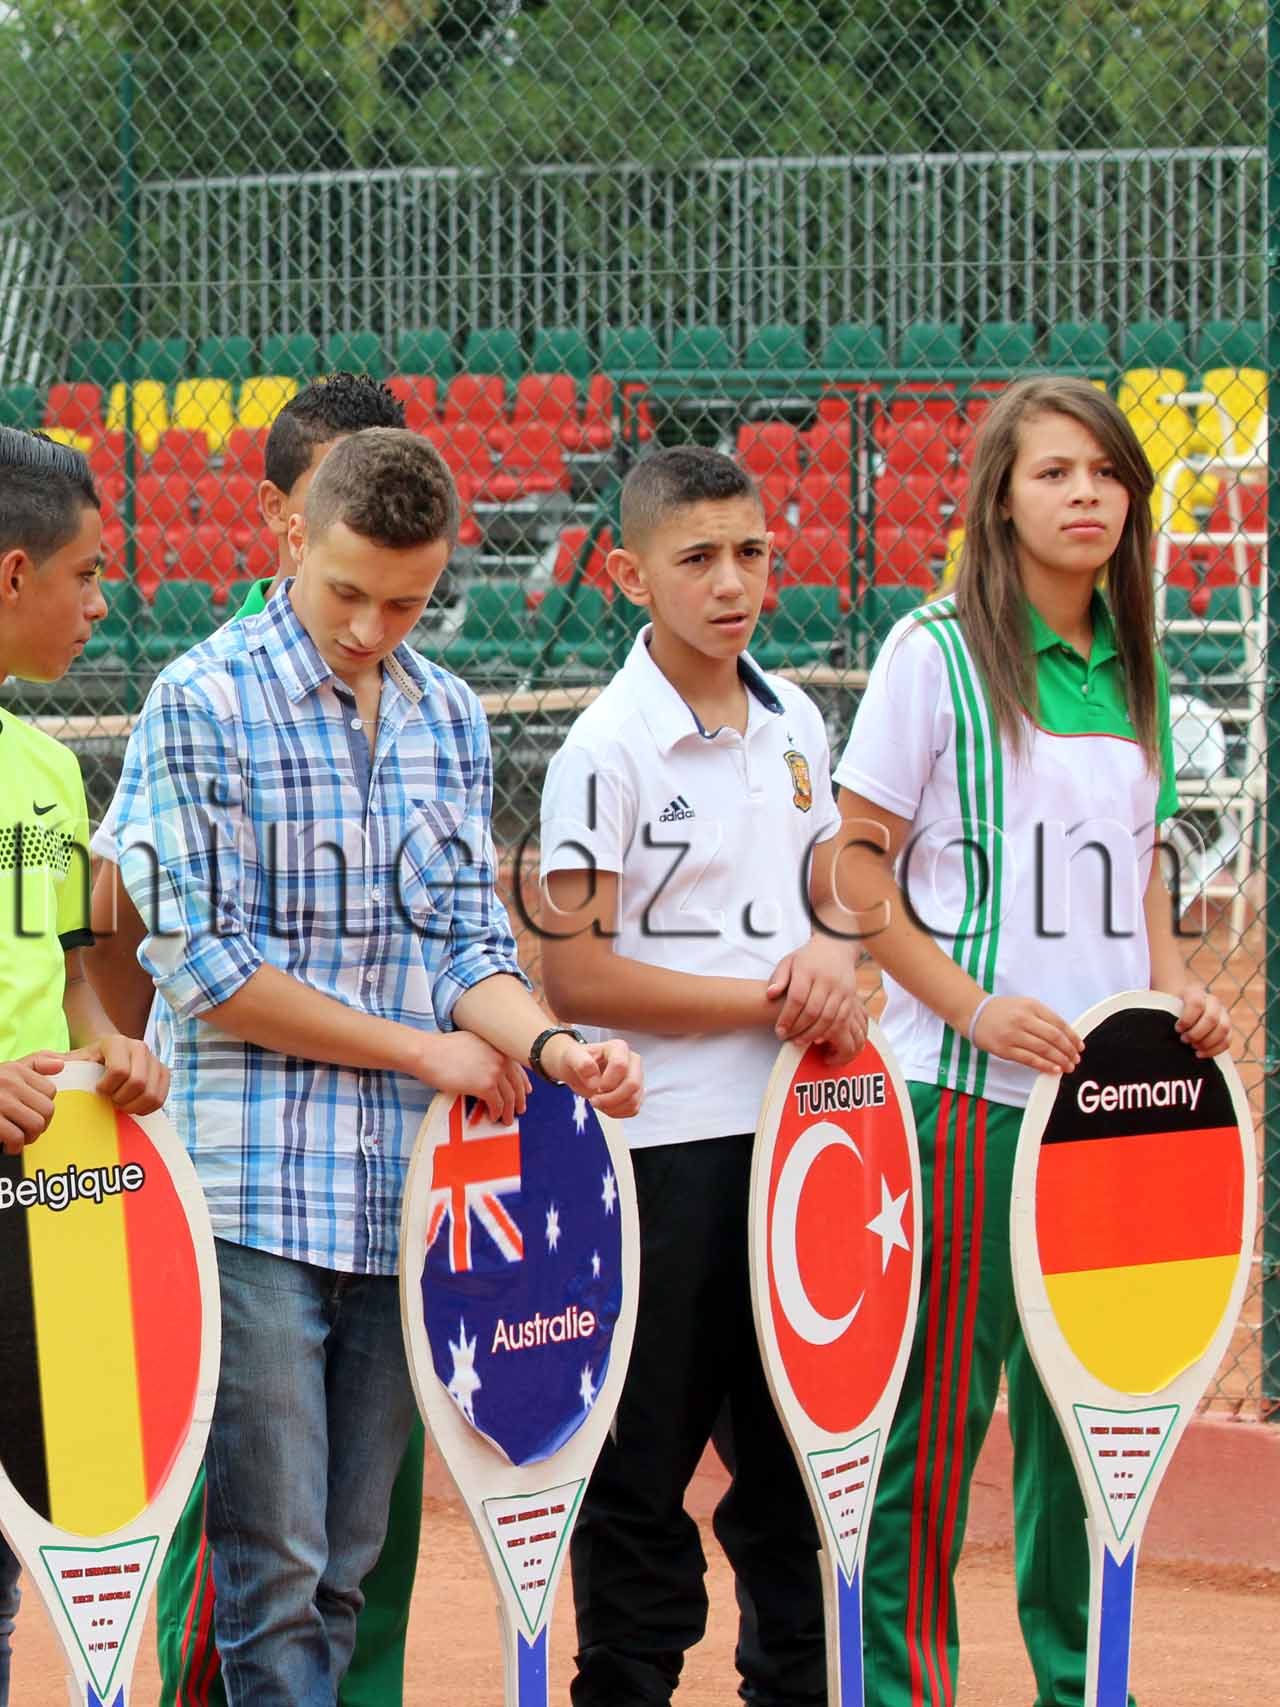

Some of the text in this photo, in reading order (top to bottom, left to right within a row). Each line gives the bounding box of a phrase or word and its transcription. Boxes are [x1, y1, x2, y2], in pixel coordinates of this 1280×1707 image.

[794, 1073, 885, 1116] TURQUIE
[1077, 1078, 1203, 1114] Germany
[491, 1305, 596, 1354] Australie
